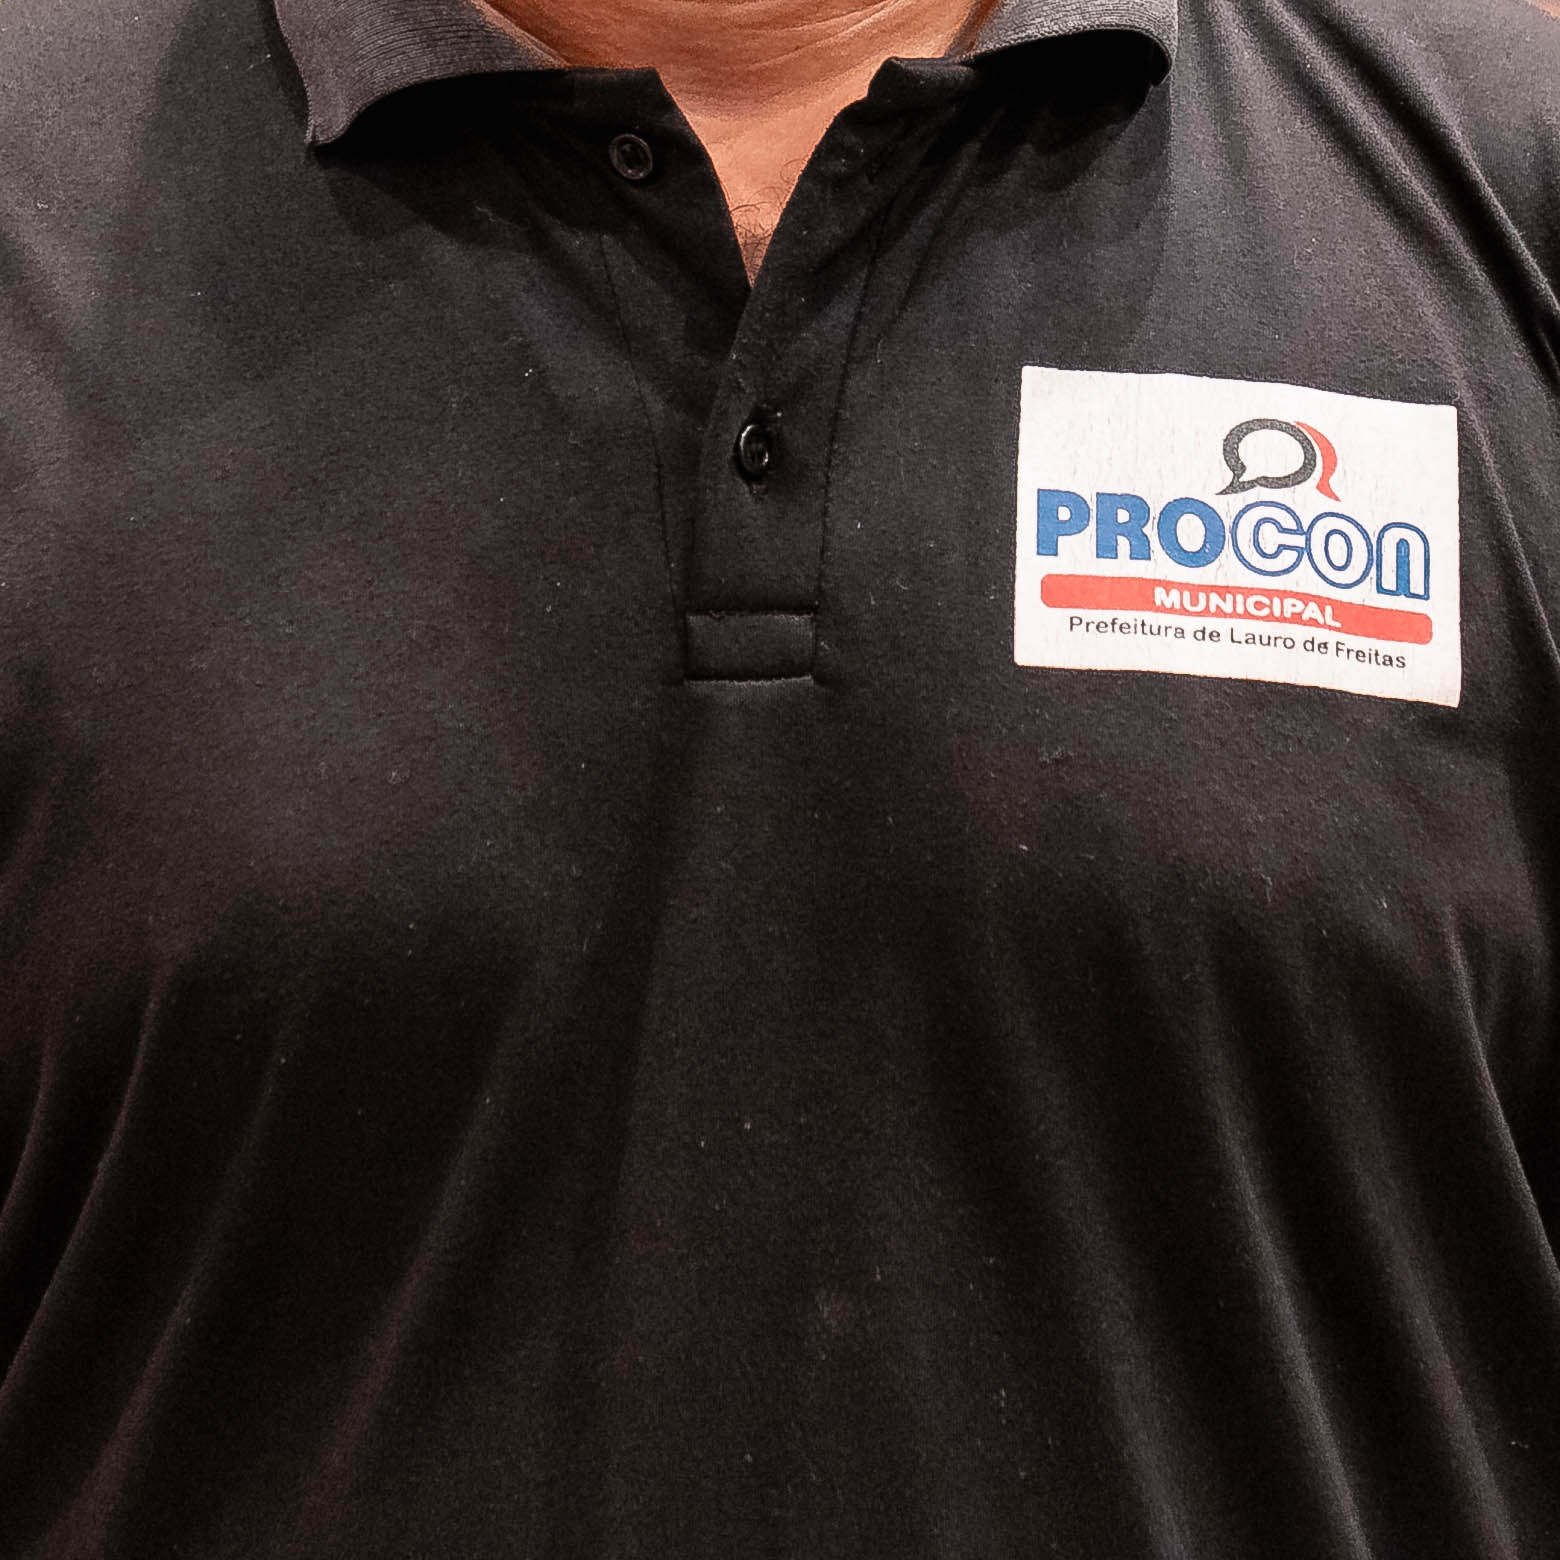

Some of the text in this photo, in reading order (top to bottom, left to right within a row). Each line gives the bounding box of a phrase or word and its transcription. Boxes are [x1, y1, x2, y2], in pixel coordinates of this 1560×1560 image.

[1154, 586, 1342, 629] MUNICIPAL
[1068, 615, 1408, 670] Prefeitura de Lauro de Freitas
